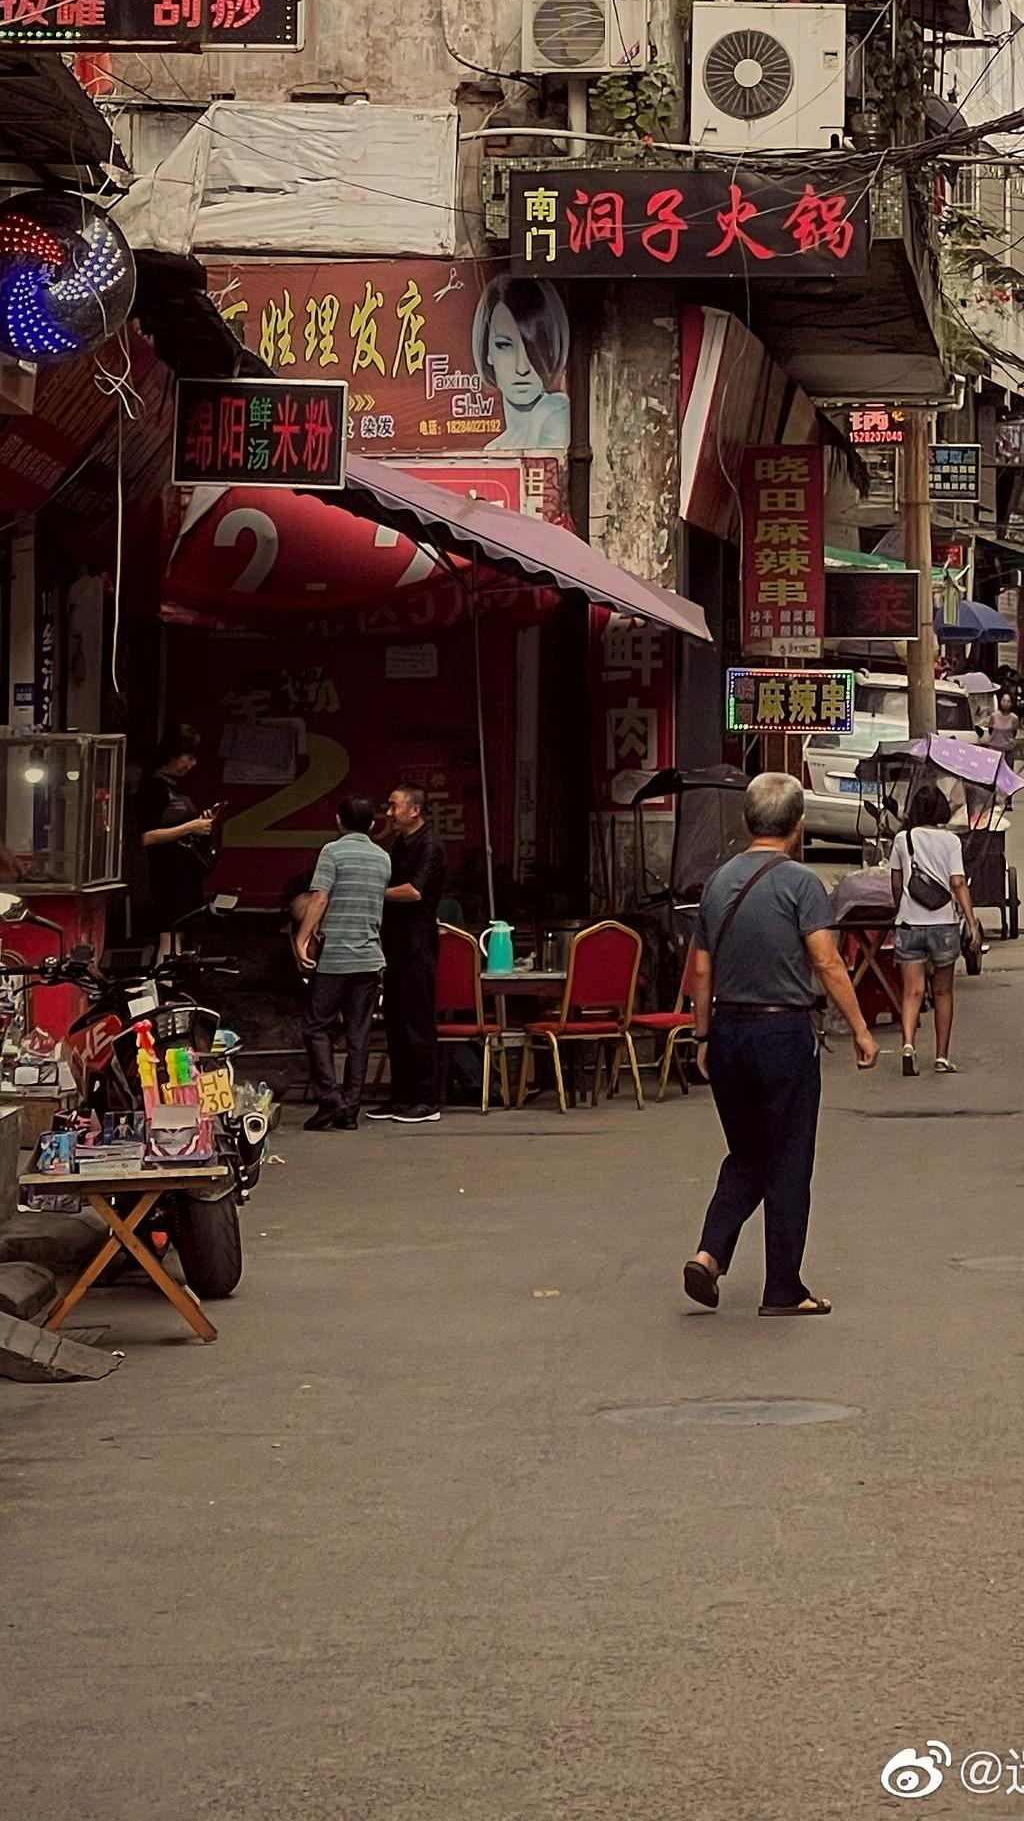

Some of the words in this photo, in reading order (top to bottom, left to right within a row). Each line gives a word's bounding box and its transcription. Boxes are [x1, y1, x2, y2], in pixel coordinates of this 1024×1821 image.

[523, 187, 559, 262] 南门
[566, 183, 855, 263] 洞子火锅
[425, 354, 482, 400] Faxing
[754, 455, 812, 606] 晓田麻辣串
[756, 677, 847, 725] 麻辣串
